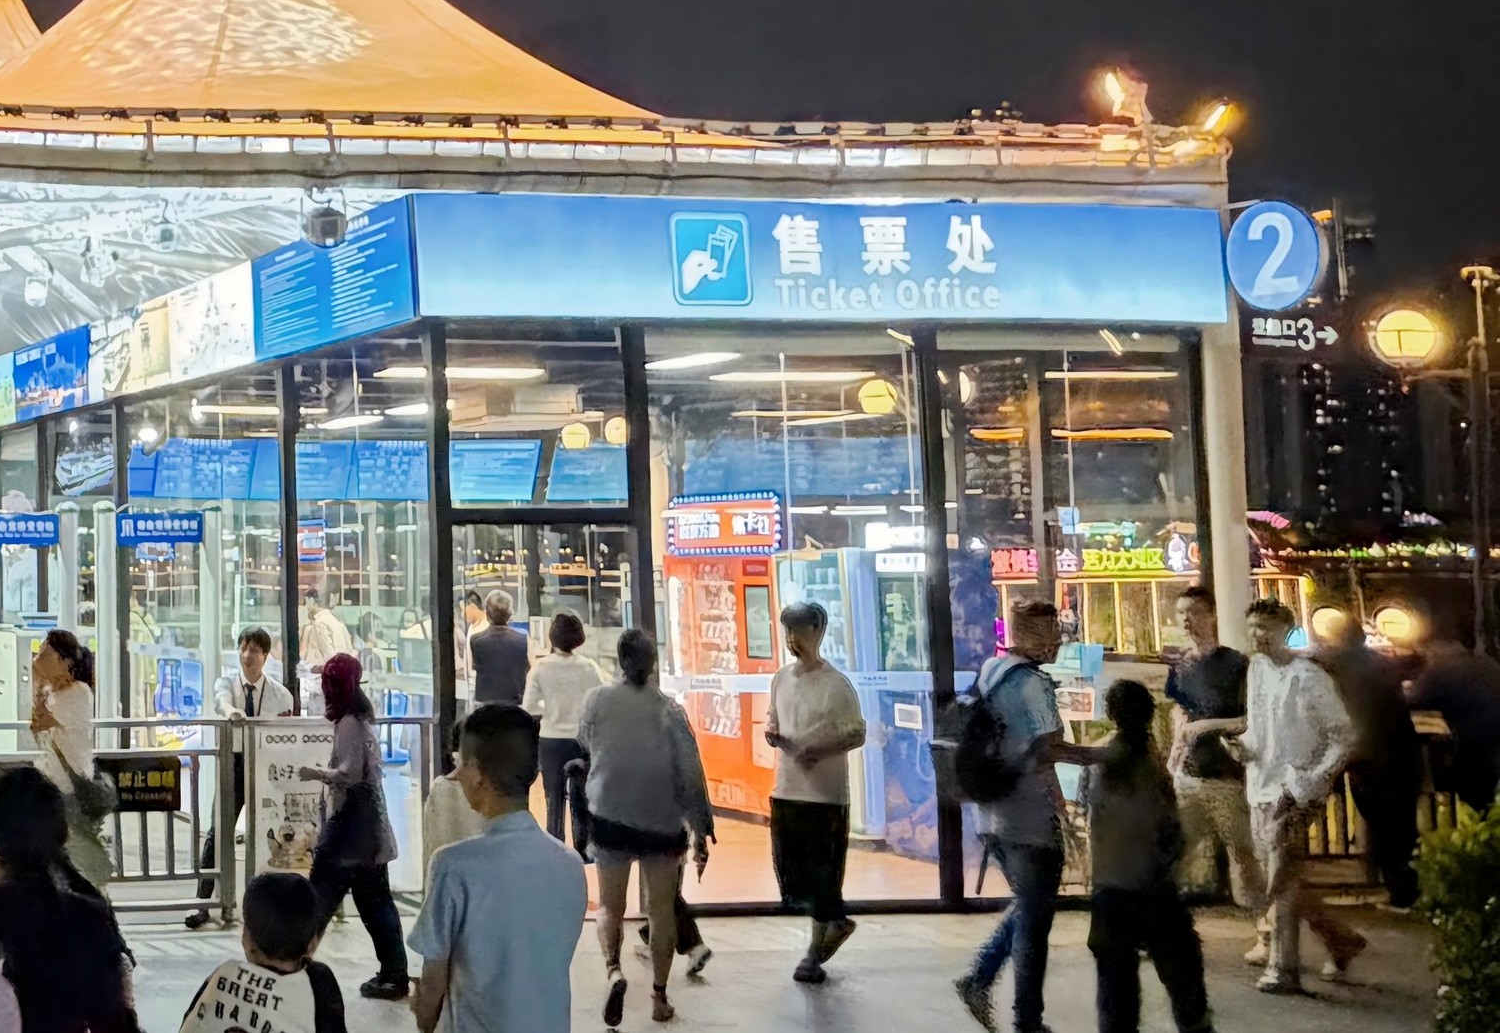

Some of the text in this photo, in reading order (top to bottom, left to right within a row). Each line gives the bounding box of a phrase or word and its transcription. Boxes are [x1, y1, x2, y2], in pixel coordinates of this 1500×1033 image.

[772, 214, 997, 275] 售票处
[1248, 211, 1299, 296] 2
[774, 277, 1000, 311] Ticket Office
[1297, 318, 1316, 351] 3
[236, 967, 277, 992] THE
